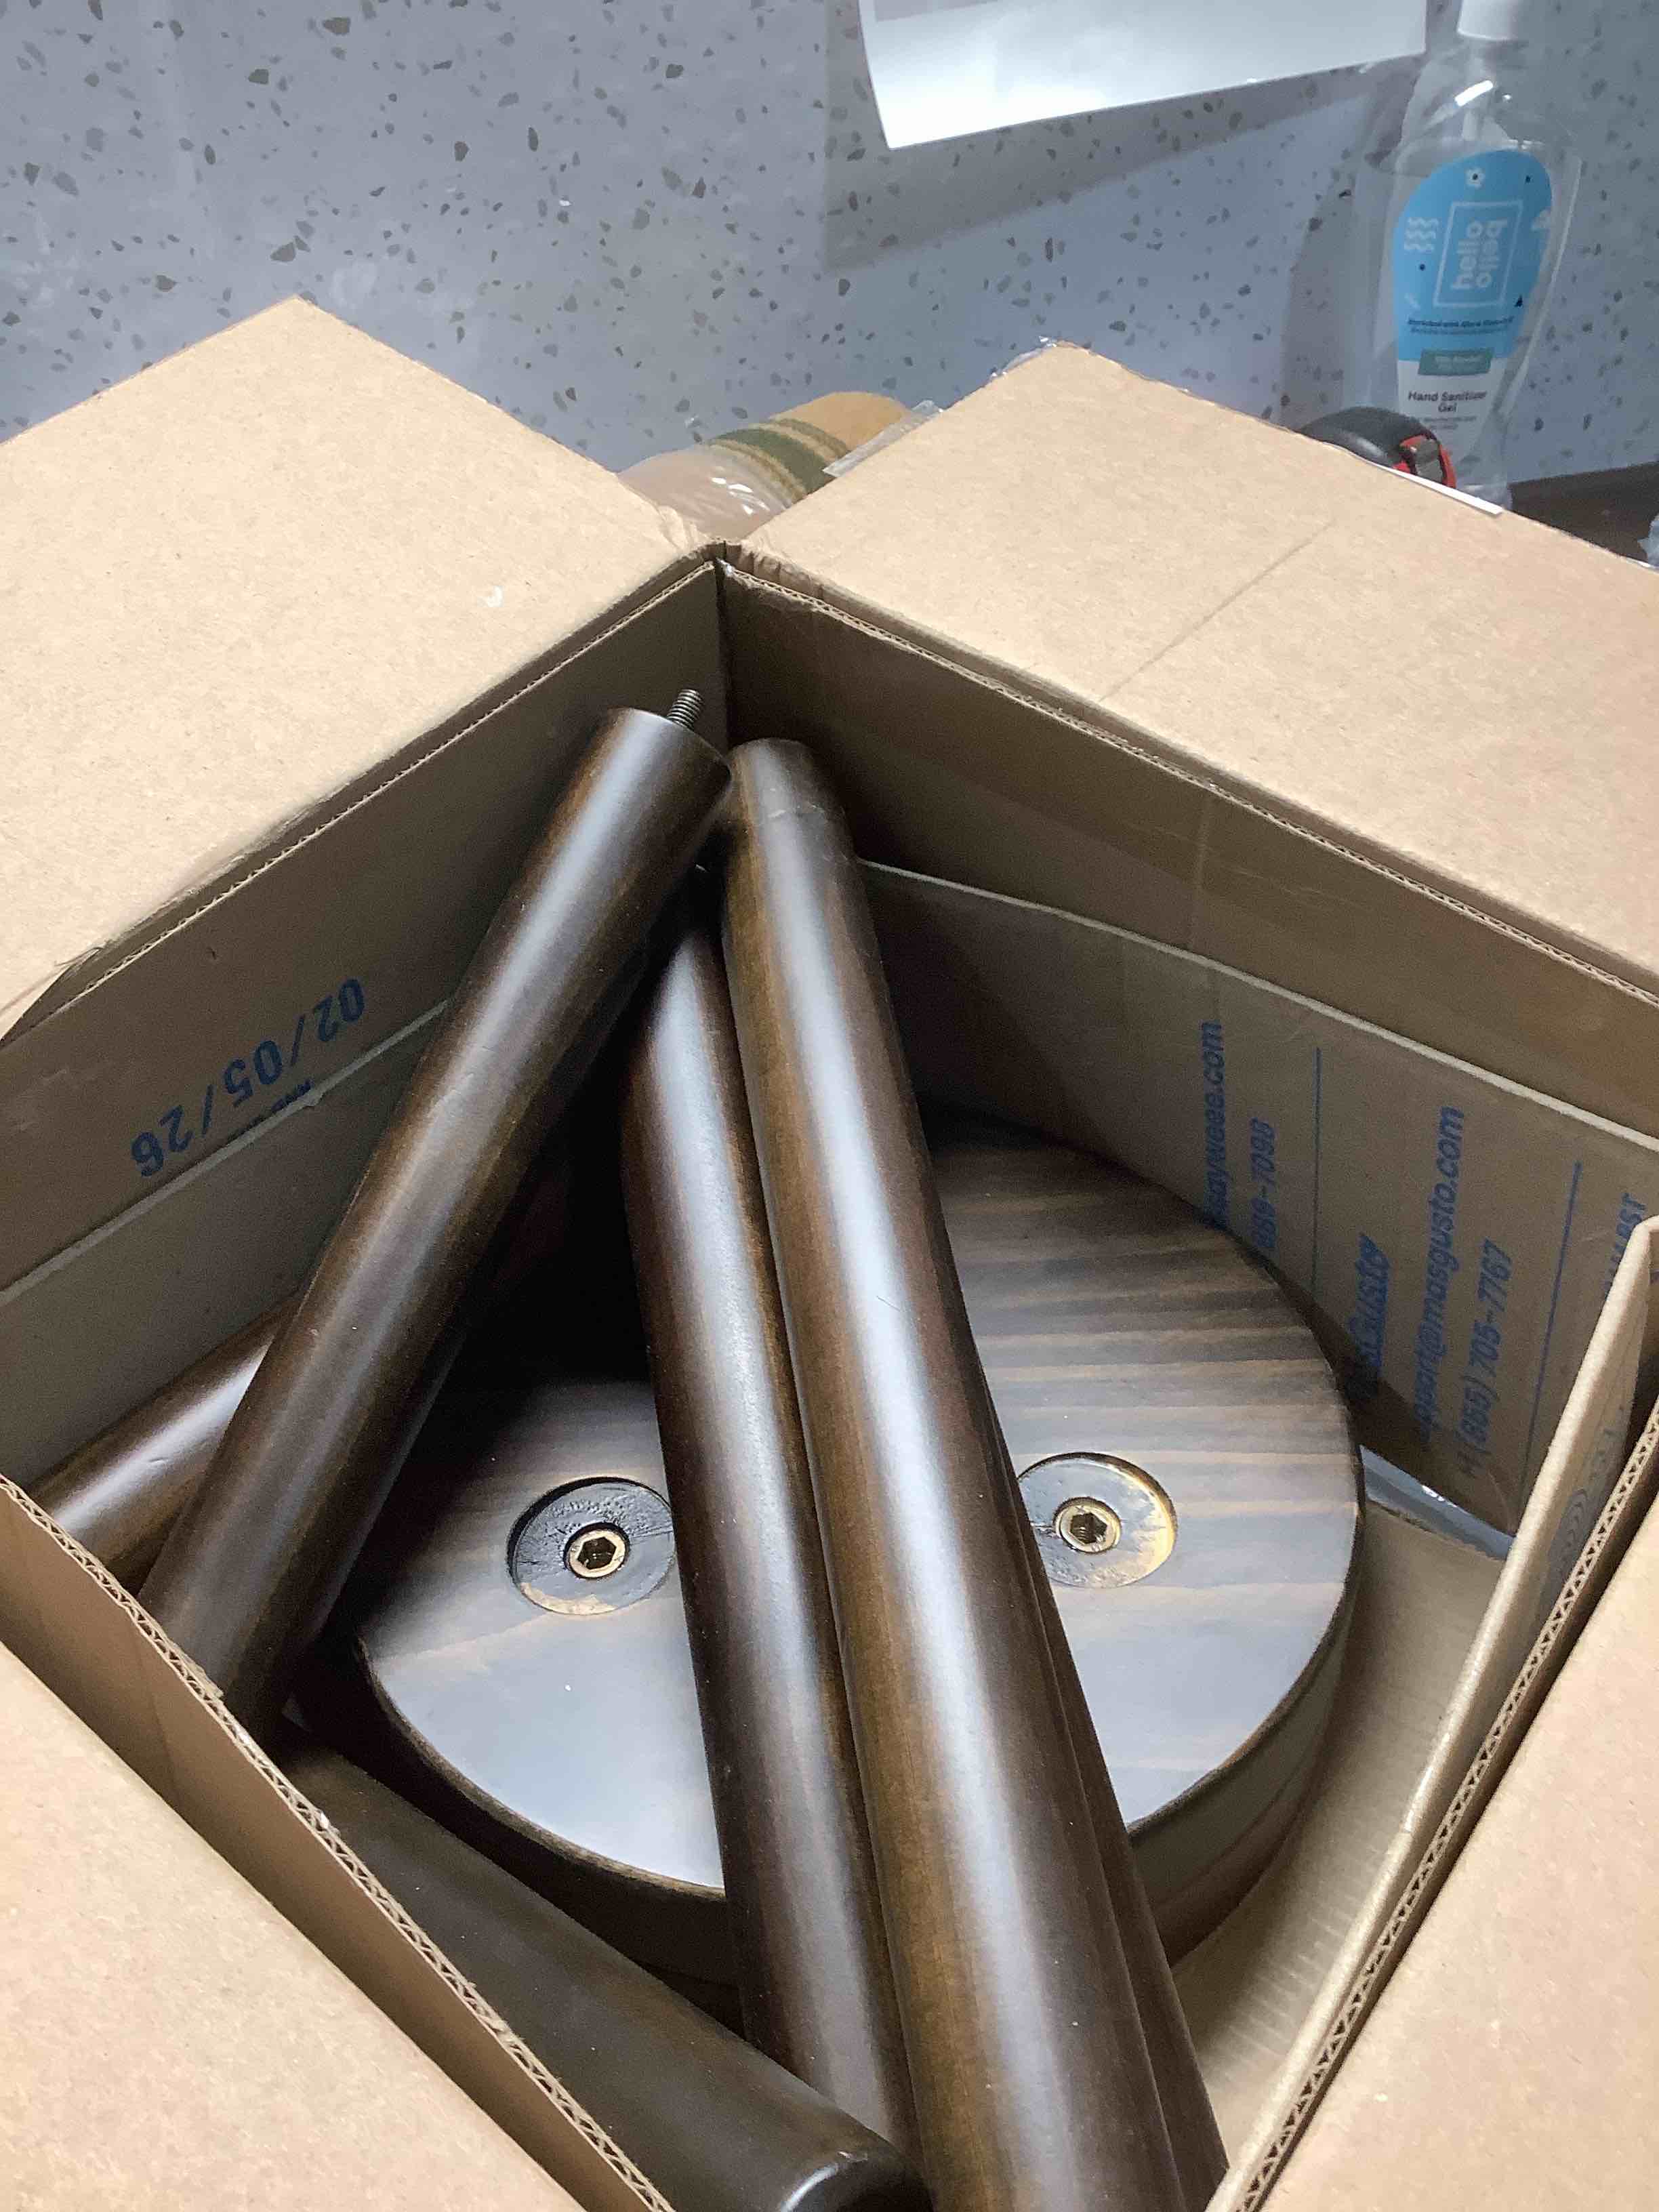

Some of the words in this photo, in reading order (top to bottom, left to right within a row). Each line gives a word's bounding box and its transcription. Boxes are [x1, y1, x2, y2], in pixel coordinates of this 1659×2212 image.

[1450, 221, 1484, 290] hello
[1408, 390, 1438, 402] Hand
[1441, 390, 1487, 402] Sanitizer
[1437, 402, 1458, 412] Gel
[131, 979, 365, 1177] 02/05/26
[1469, 1238, 1513, 1378] 705-7767
